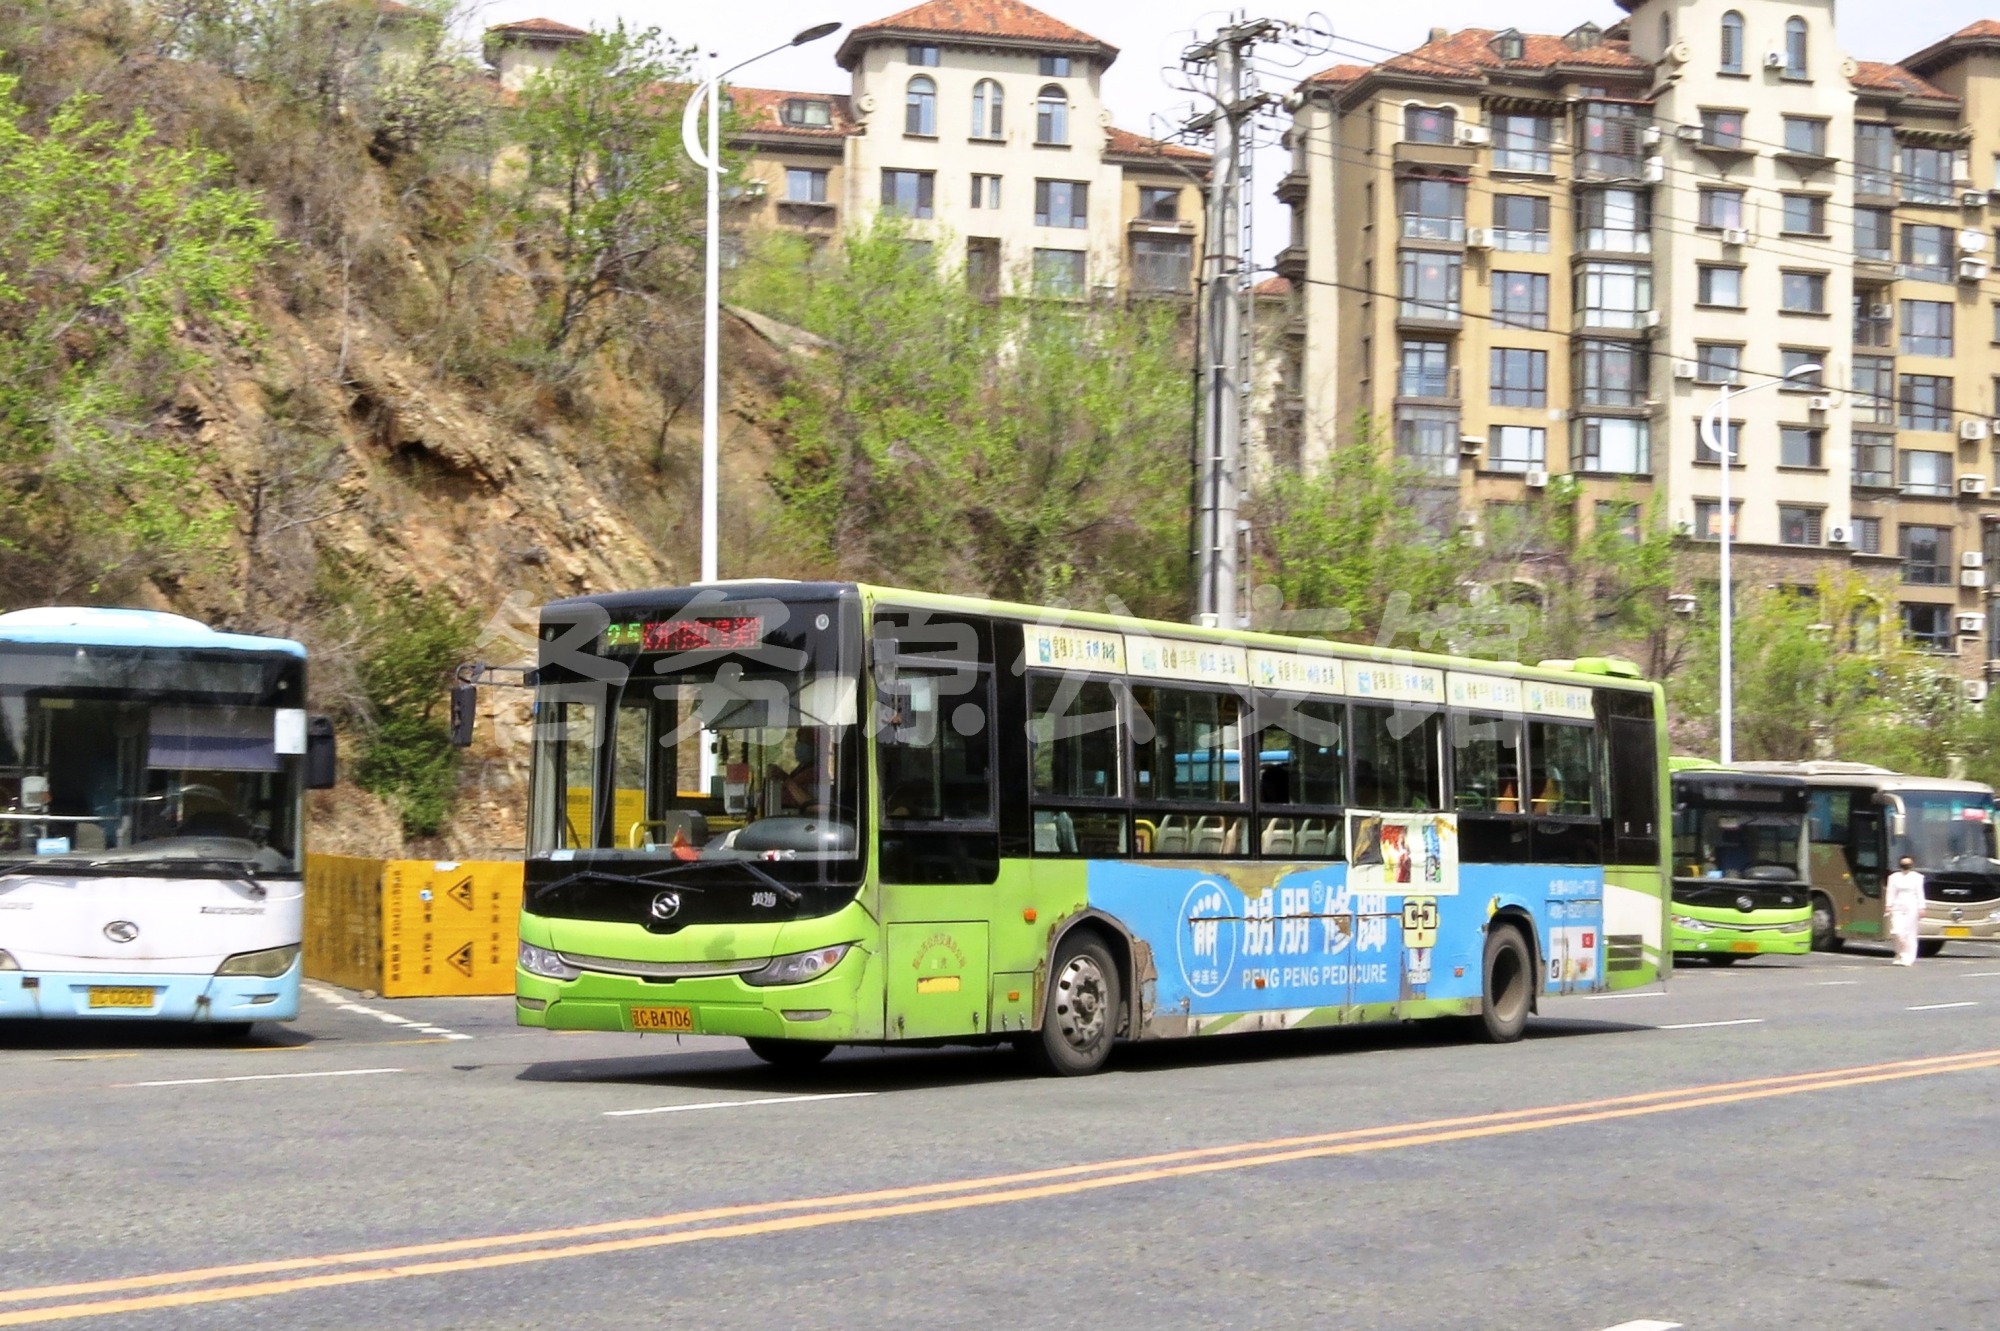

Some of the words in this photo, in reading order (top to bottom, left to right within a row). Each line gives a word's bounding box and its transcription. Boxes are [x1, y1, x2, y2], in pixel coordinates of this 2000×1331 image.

[1242, 966, 1280, 990] PENG
[1283, 966, 1319, 988] PENG
[1322, 963, 1388, 985] PEDICURE
